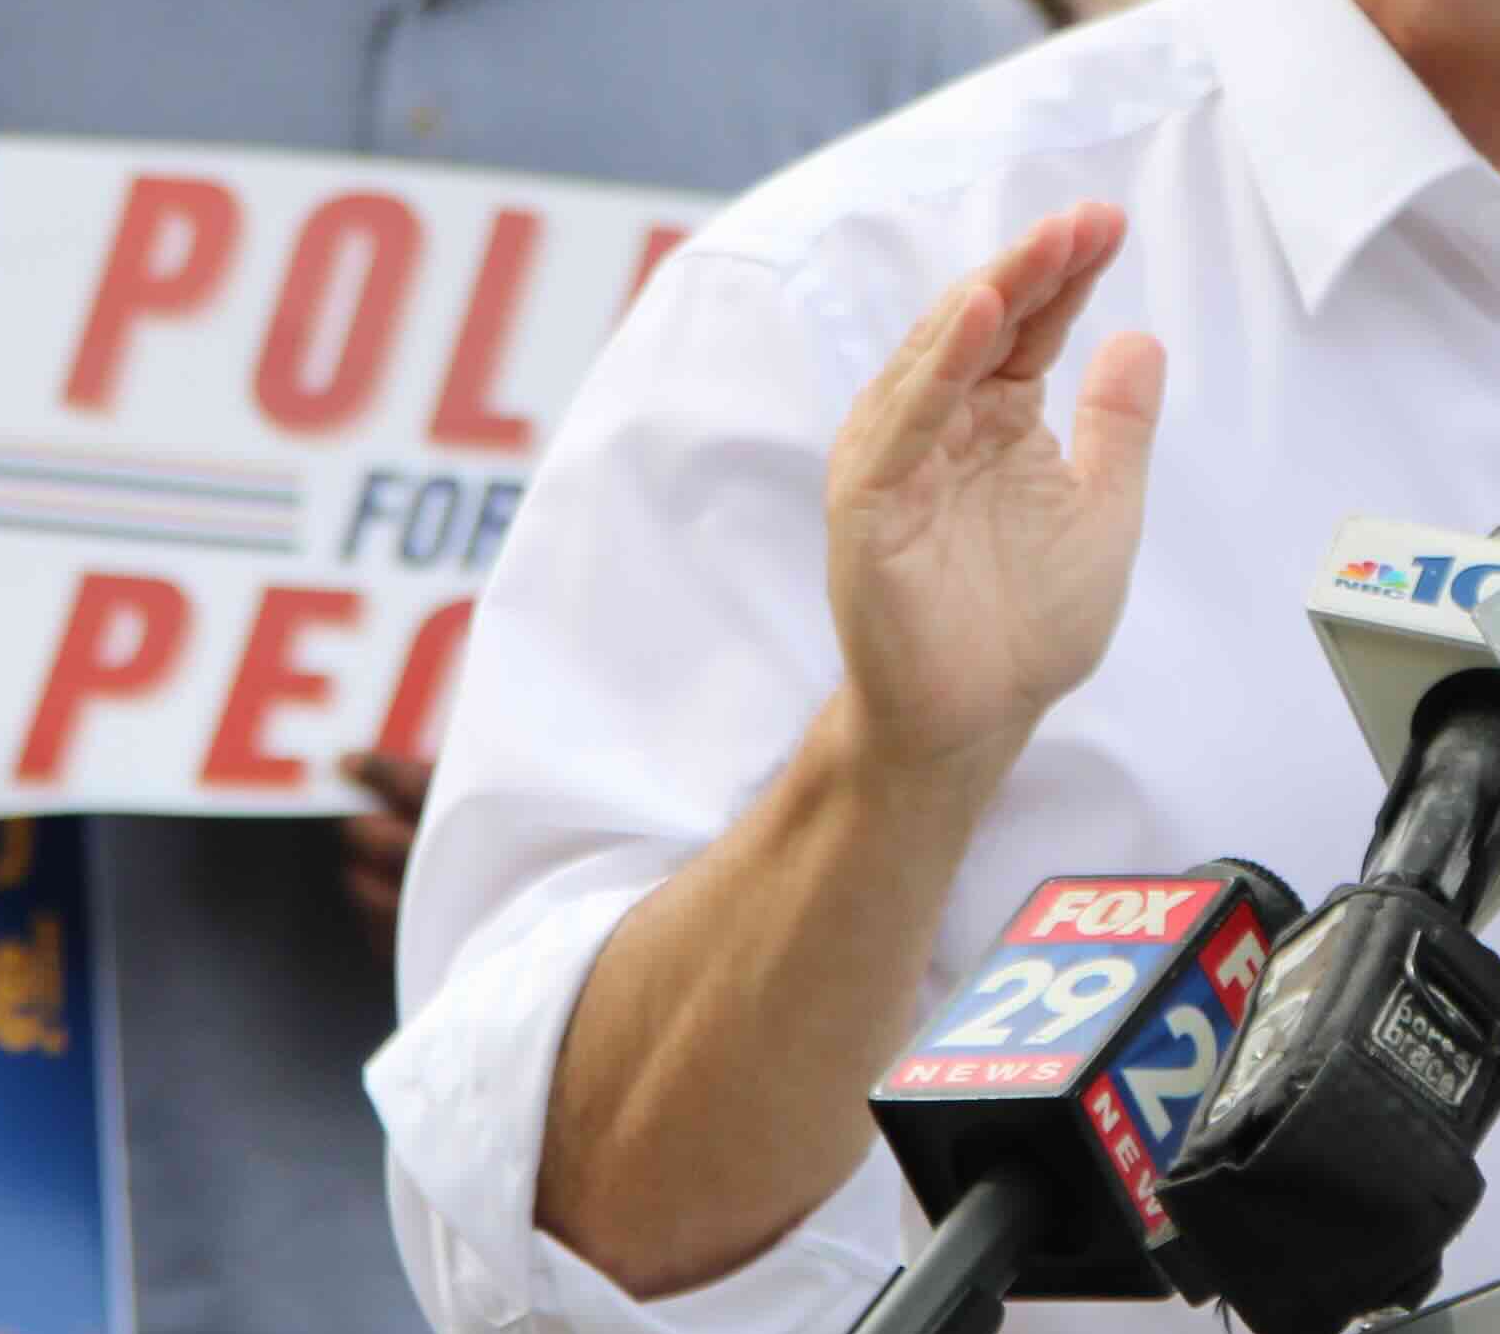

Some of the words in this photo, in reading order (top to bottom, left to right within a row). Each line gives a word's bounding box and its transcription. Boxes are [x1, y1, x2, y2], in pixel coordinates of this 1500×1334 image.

[1029, 890, 1197, 938] FOX
[930, 958, 1138, 1048] 29
[904, 1062, 1062, 1083] NEWS
